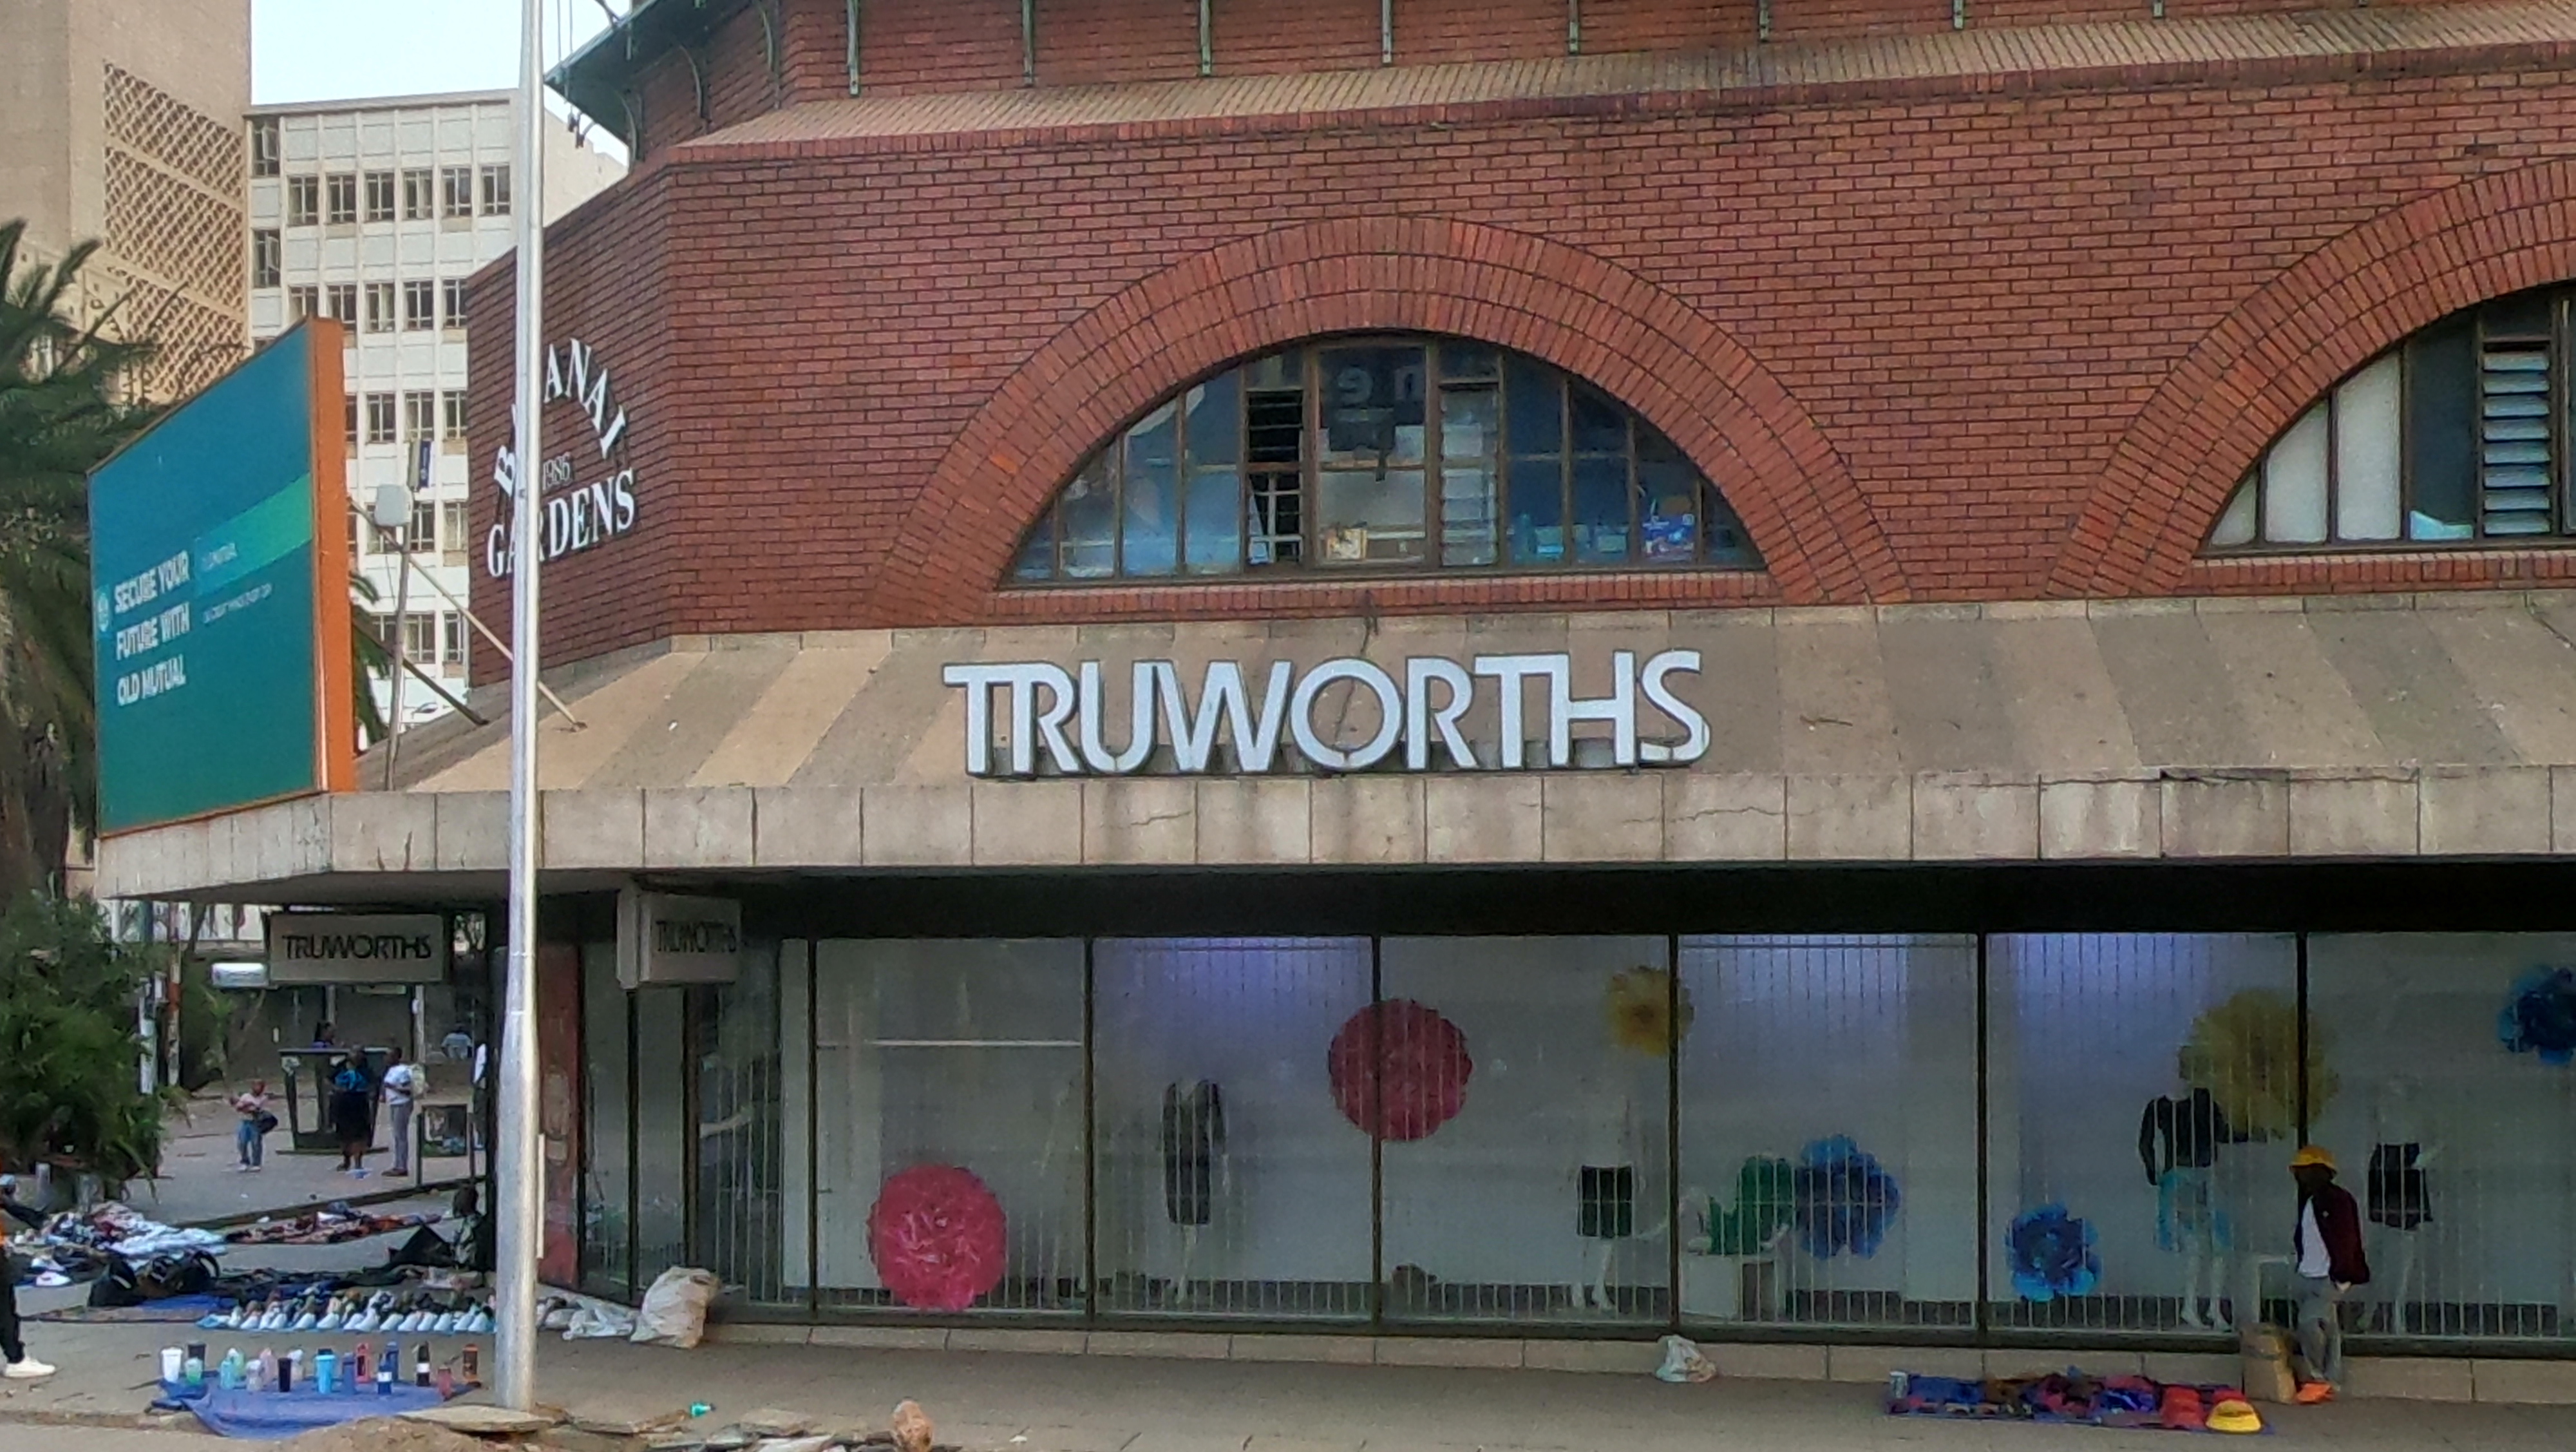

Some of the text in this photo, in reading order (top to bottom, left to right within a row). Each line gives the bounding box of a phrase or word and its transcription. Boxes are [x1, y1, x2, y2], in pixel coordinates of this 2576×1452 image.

[115, 568, 157, 613] SECURE
[158, 550, 190, 594] YOUR
[117, 617, 158, 661] FUTURE
[160, 602, 190, 643] WITH
[118, 654, 186, 707] OLD MUTUAL
[943, 651, 1710, 775] TRUWORTHS
[282, 934, 431, 959] TRUWORTHS
